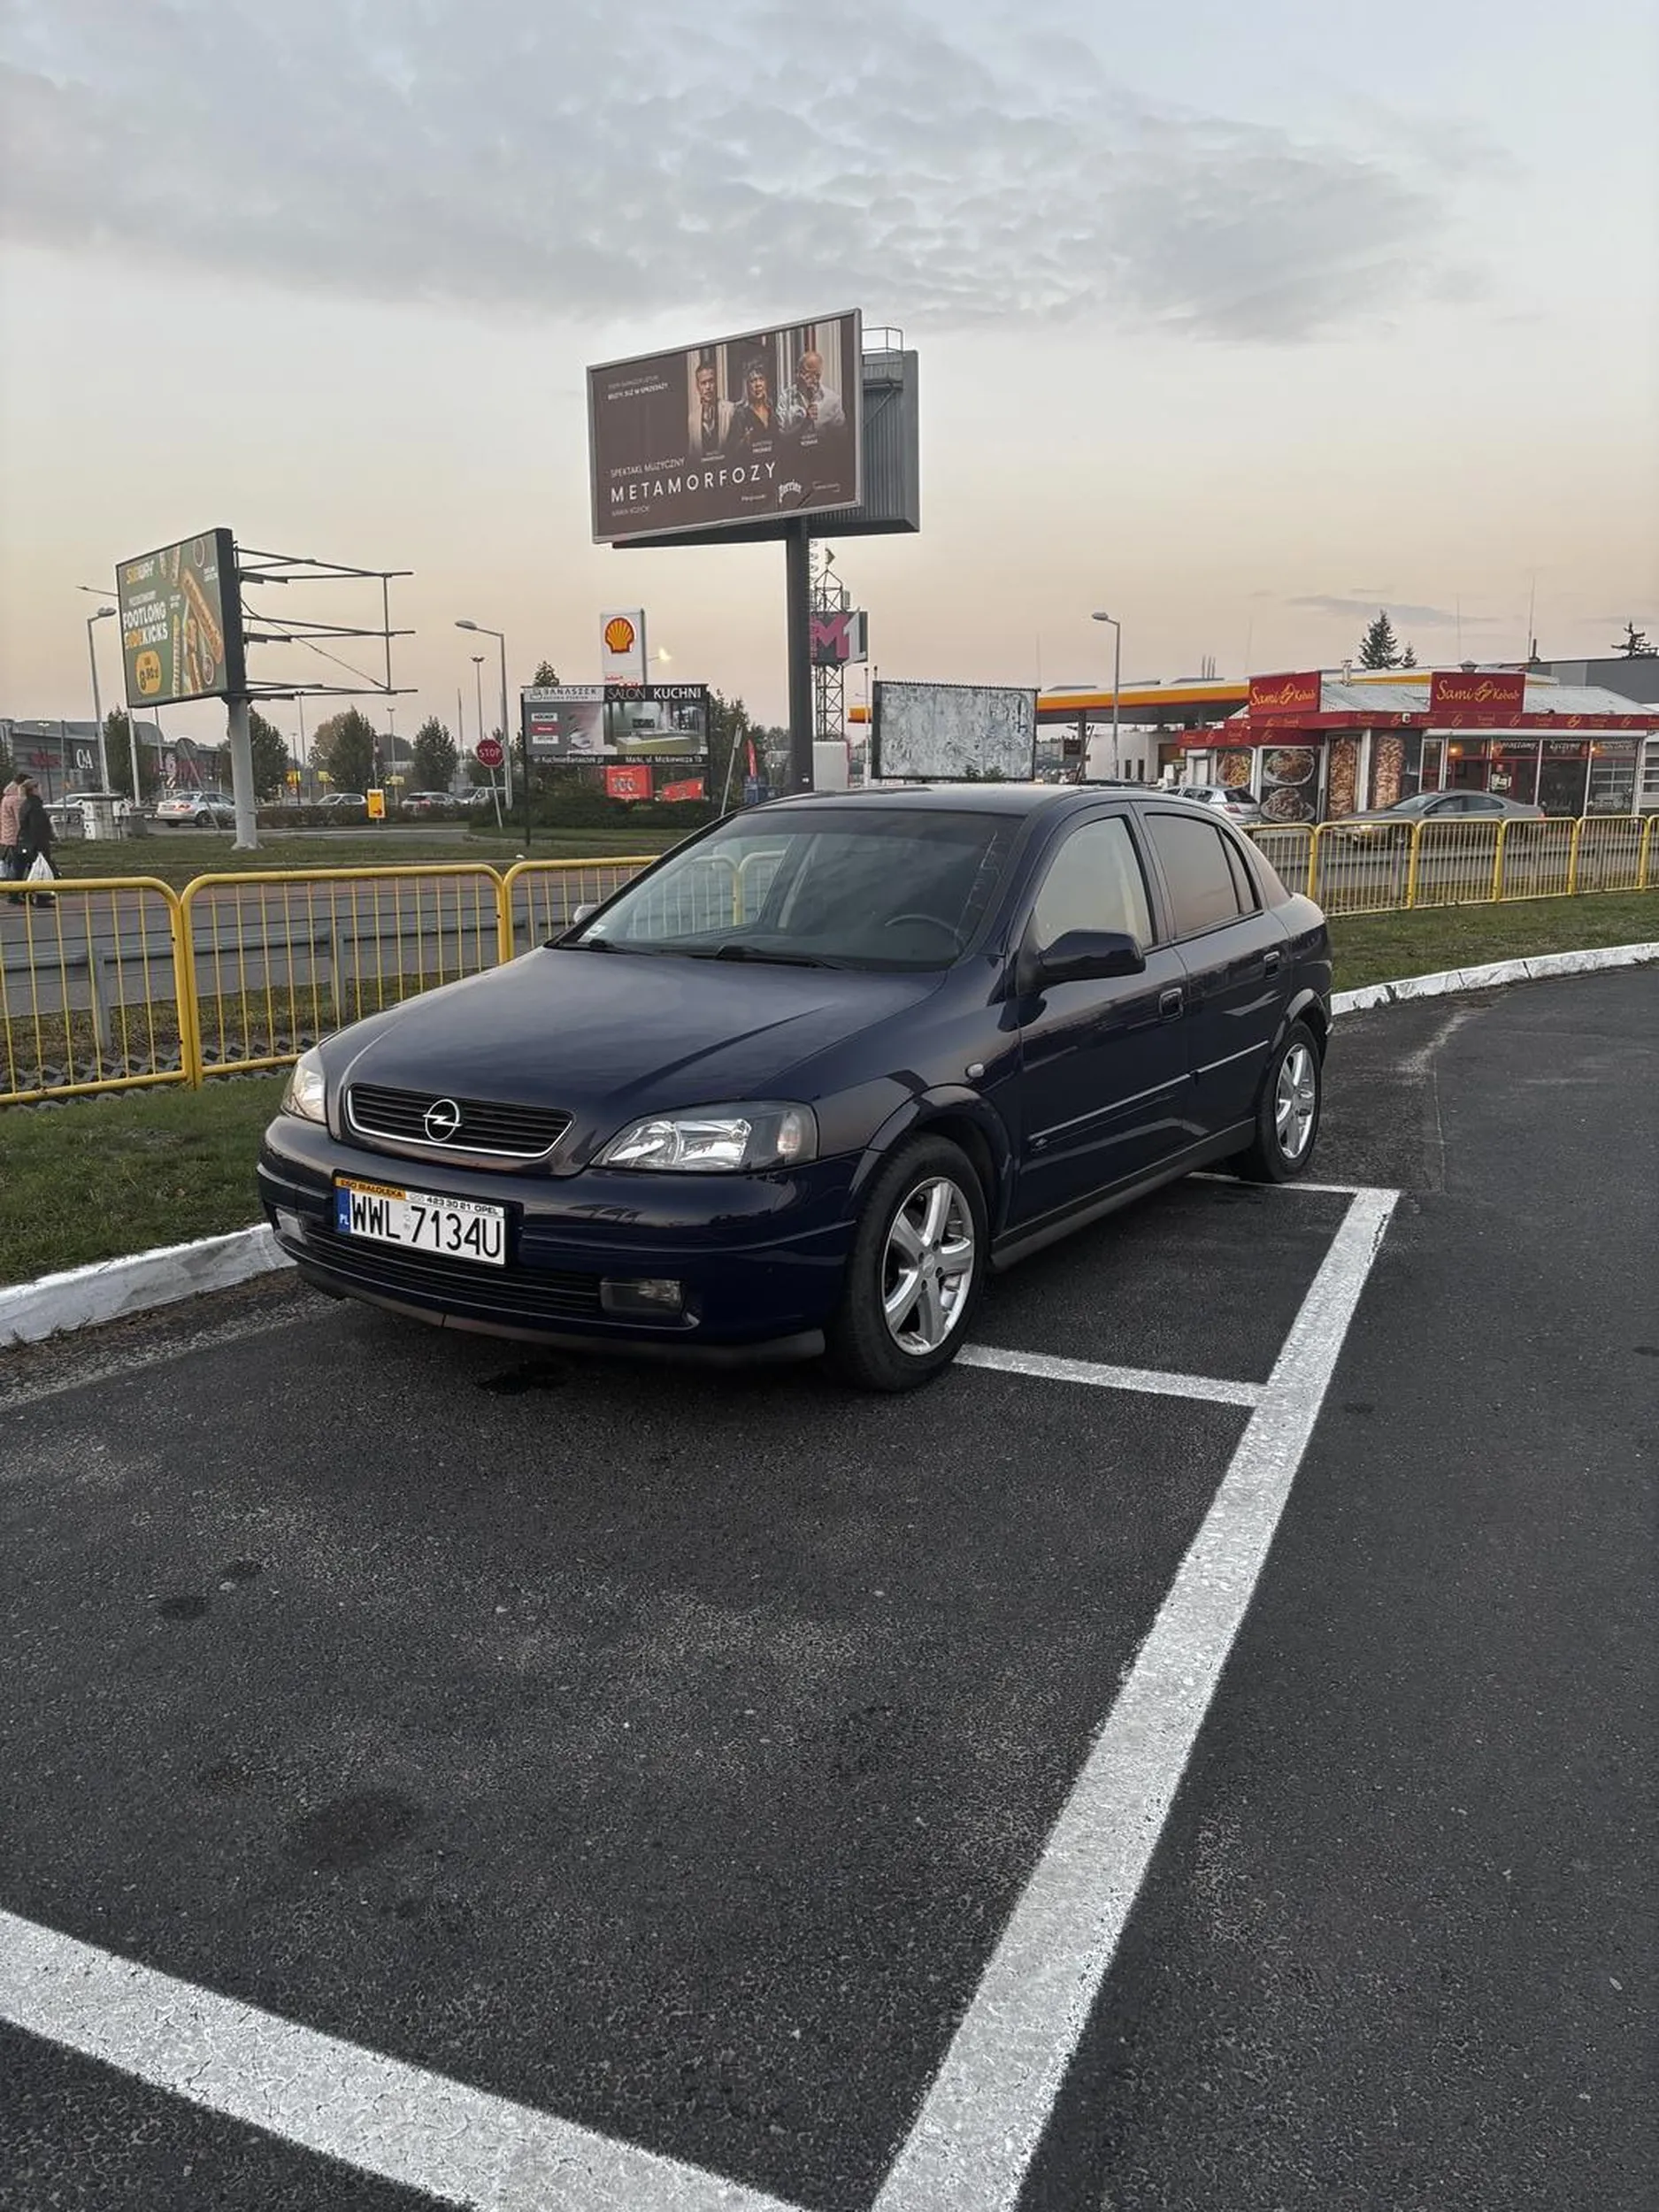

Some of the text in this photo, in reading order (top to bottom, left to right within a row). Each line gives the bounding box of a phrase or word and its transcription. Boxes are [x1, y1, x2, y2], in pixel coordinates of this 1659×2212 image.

[611, 462, 776, 503] METAMORFOZY
[123, 602, 166, 628] FOOTLONG
[608, 687, 702, 701] SALON KUCHNI
[1436, 680, 1475, 701] Sami
[479, 748, 500, 758] STOP
[474, 1205, 499, 1215] OPEL
[339, 1213, 349, 1225] PL
[351, 1193, 501, 1258] WWL 7134U
